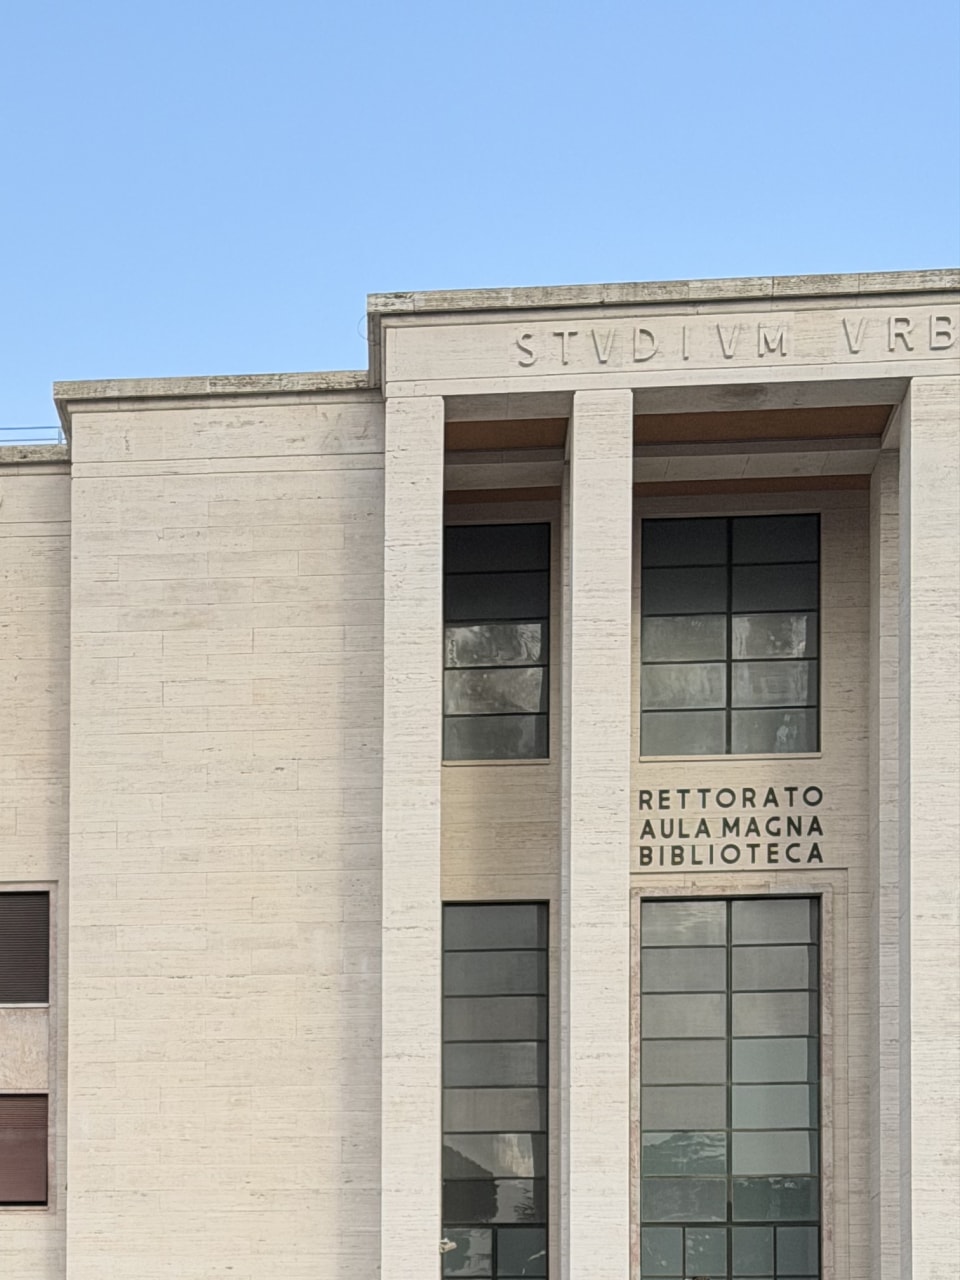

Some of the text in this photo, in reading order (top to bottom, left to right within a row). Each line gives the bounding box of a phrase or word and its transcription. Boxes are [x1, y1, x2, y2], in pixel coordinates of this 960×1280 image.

[516, 324, 788, 367] STVDIVM
[639, 786, 824, 811] RETTORATO
[640, 815, 824, 840] AULA MAGNA
[639, 842, 824, 867] BIBLIOTECA
